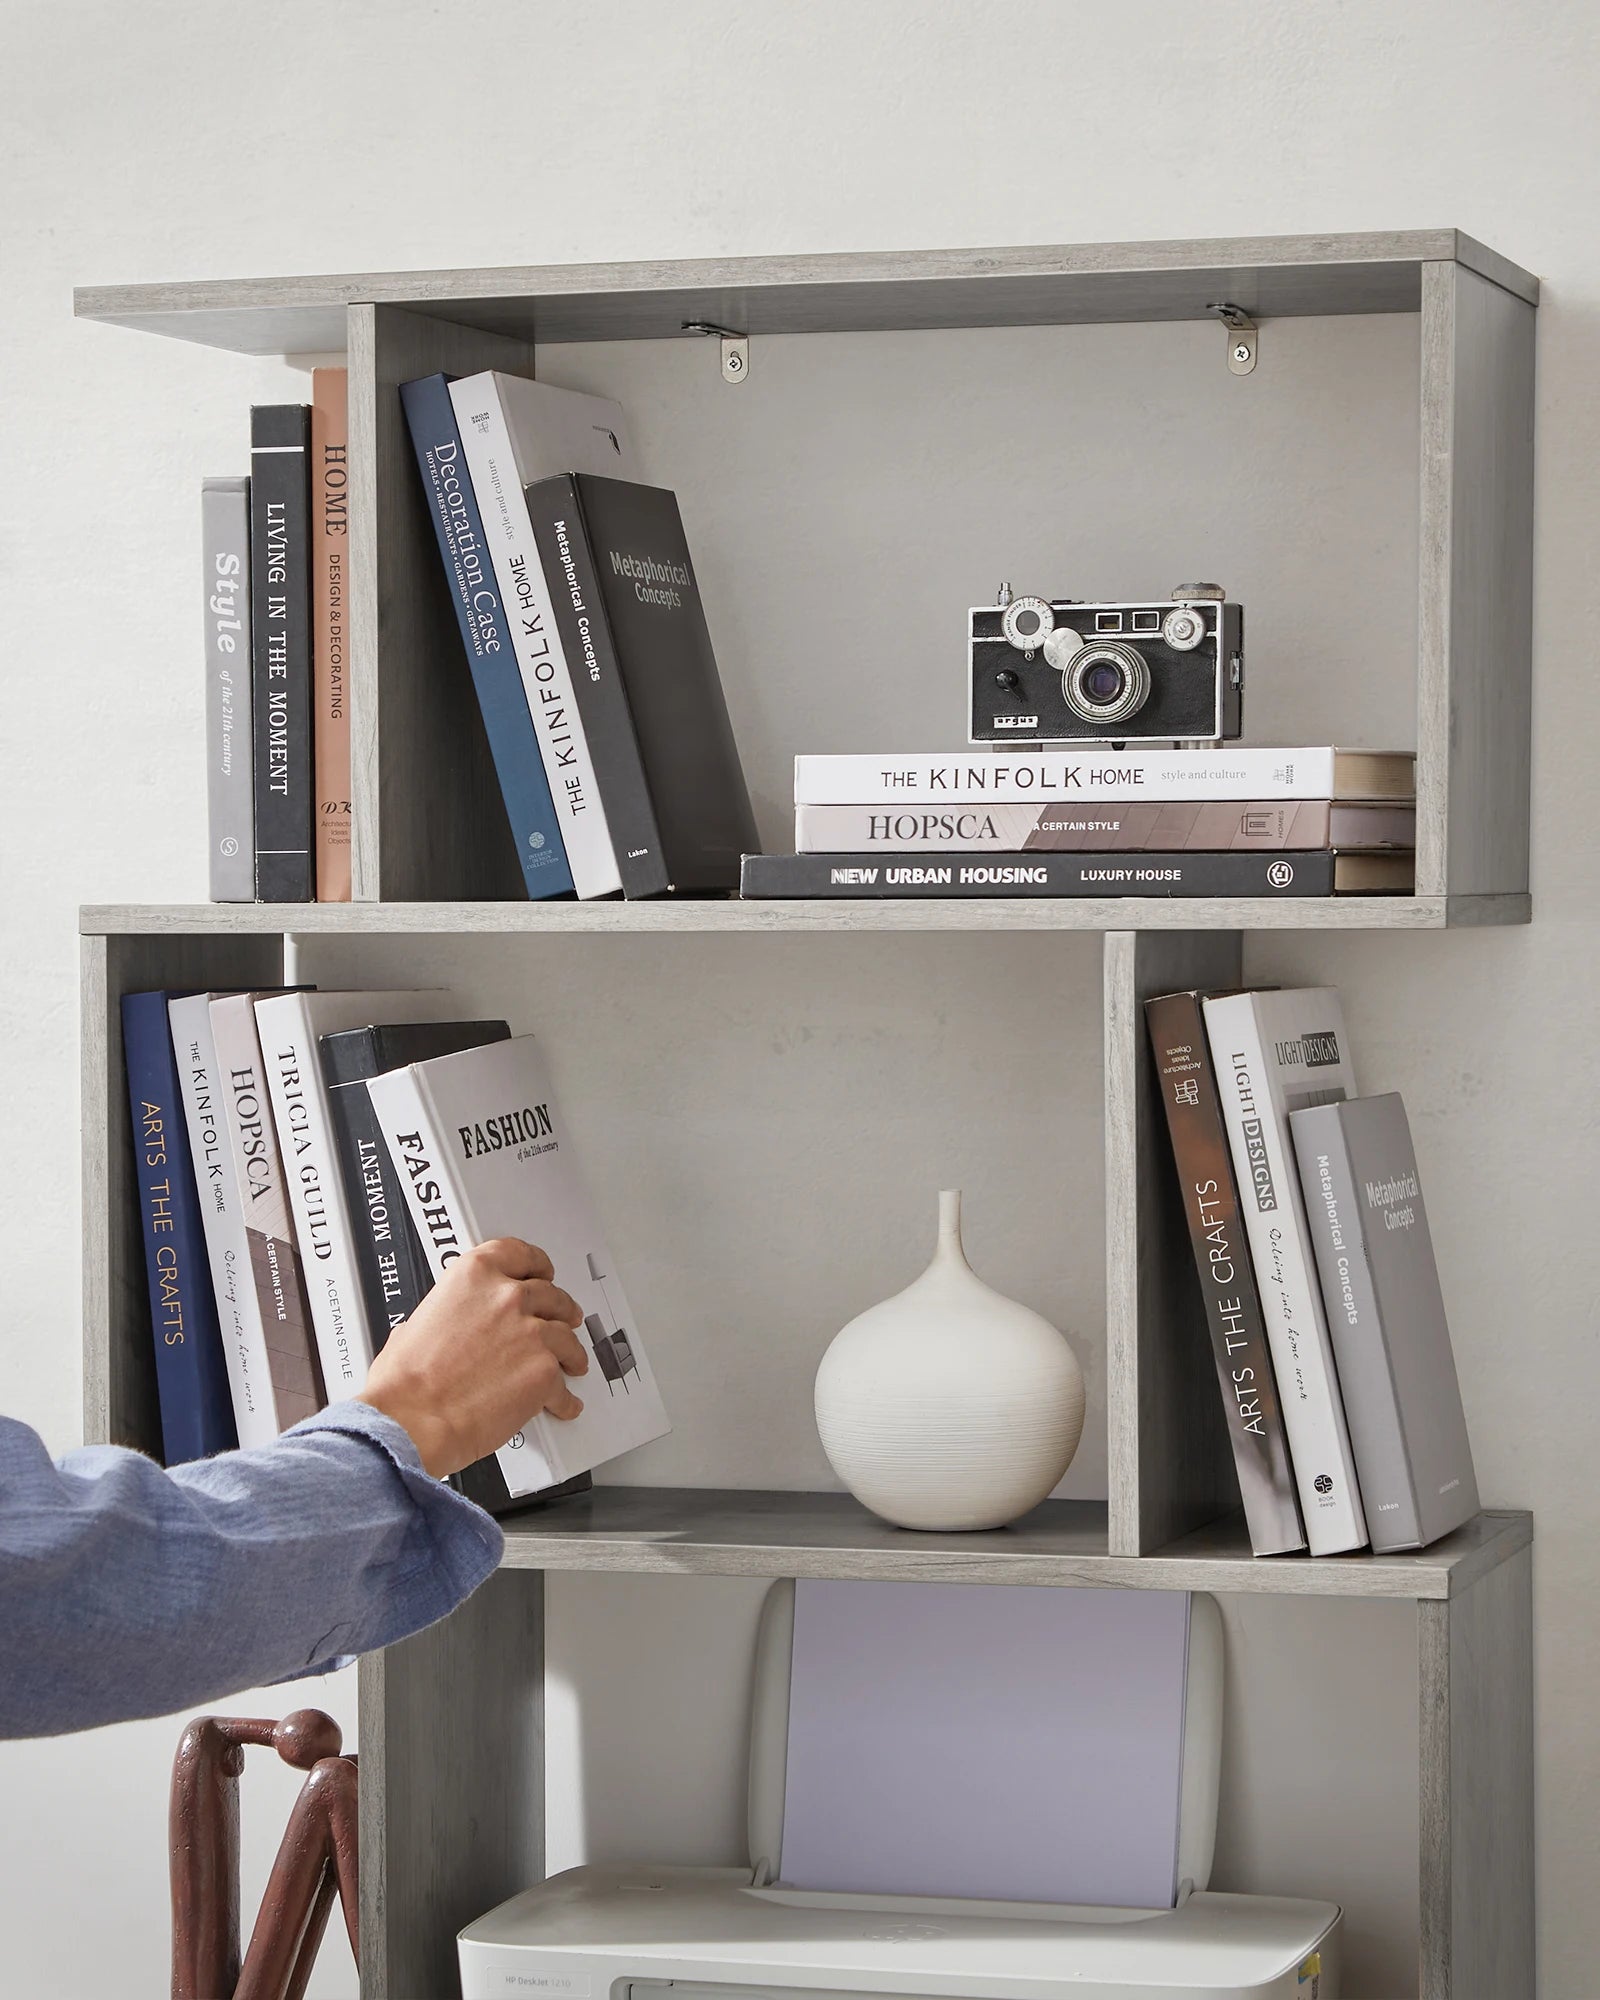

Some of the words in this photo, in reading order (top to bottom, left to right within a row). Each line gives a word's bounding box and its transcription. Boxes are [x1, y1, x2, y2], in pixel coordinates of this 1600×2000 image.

[325, 444, 347, 536] HOME
[488, 458, 502, 495] culture
[495, 495, 508, 515] and
[267, 502, 288, 583] LIVING
[434, 440, 483, 588] Decoration
[474, 591, 500, 654] Case
[502, 515, 514, 541] style
[426, 450, 440, 486] HOTELS
[437, 492, 458, 556] RESTAURANTS
[454, 562, 470, 604] GARDENS
[466, 610, 483, 657] GETAWAYS
[610, 551, 691, 586] Metaphorical
[329, 554, 341, 606] DESIGN
[509, 554, 535, 609] HOME
[554, 520, 586, 611] Metaphorical
[577, 616, 600, 682] Concepts
[634, 582, 681, 610] Concepts
[210, 552, 242, 653] Style
[268, 596, 286, 620] IN
[330, 611, 340, 622] &
[220, 670, 232, 684] of
[268, 631, 287, 679] THE
[330, 626, 342, 719] DECORATING
[222, 689, 232, 704] the
[522, 613, 578, 767] KINFOLK
[269, 692, 288, 796] MOMENT
[998, 718, 1034, 726] argus
[222, 733, 233, 776] century
[565, 776, 586, 816] THE
[881, 771, 917, 787] THE
[929, 767, 1082, 789] KINFOLK
[1090, 768, 1145, 785] HOME
[1161, 769, 1186, 780] style
[1188, 769, 1207, 779] and
[1209, 769, 1247, 779] culture
[321, 820, 352, 828] Architectu
[868, 814, 1001, 840] HOPSCA
[1033, 822, 1040, 831] A
[1042, 822, 1086, 831] CERTAIN
[1087, 821, 1120, 830] STYLE
[627, 848, 648, 859] Lakon
[830, 868, 878, 884] NEW
[885, 868, 952, 884] URBAN
[959, 867, 1048, 884] HOUSING
[1080, 869, 1133, 881] LUXURY
[1136, 869, 1182, 880] HOUSE
[190, 1041, 200, 1063] THE
[1274, 1041, 1304, 1066] LIGHT
[1303, 1036, 1340, 1063] DESIGNS
[140, 1101, 167, 1167] ARTS
[192, 1068, 223, 1179] KINFOLK
[231, 1067, 272, 1203] HOPSCA
[458, 1103, 553, 1159] FASHION
[1231, 1052, 1257, 1117] LIGHT
[1244, 1119, 1275, 1211] DESIGNS
[150, 1178, 174, 1233] THE
[213, 1183, 226, 1213] HOME
[357, 1139, 392, 1242] MOMENT
[396, 1130, 462, 1270] FASHI
[1365, 1170, 1419, 1209] Metaphorical
[278, 1045, 313, 1157] TRICIA
[300, 1163, 333, 1261] GUILD
[336, 1338, 353, 1380] STYLE
[1196, 1179, 1235, 1284] CRAFTS
[1384, 1204, 1415, 1231] Concepts
[265, 1234, 274, 1242] A
[1317, 1154, 1346, 1251] Metaphorical
[1337, 1258, 1358, 1325] Concepts
[266, 1242, 281, 1287] CERTAIN
[378, 1252, 401, 1303] THE
[156, 1246, 185, 1347] CRAFTS
[274, 1288, 286, 1320] STYLE
[1218, 1296, 1248, 1356] THE
[1288, 1327, 1300, 1360] home
[239, 1344, 249, 1374] home
[1232, 1367, 1266, 1436] ARTS
[1378, 1502, 1399, 1512] Lakon
[505, 1976, 516, 1984] HP
[518, 1976, 549, 1986] DeskJet
